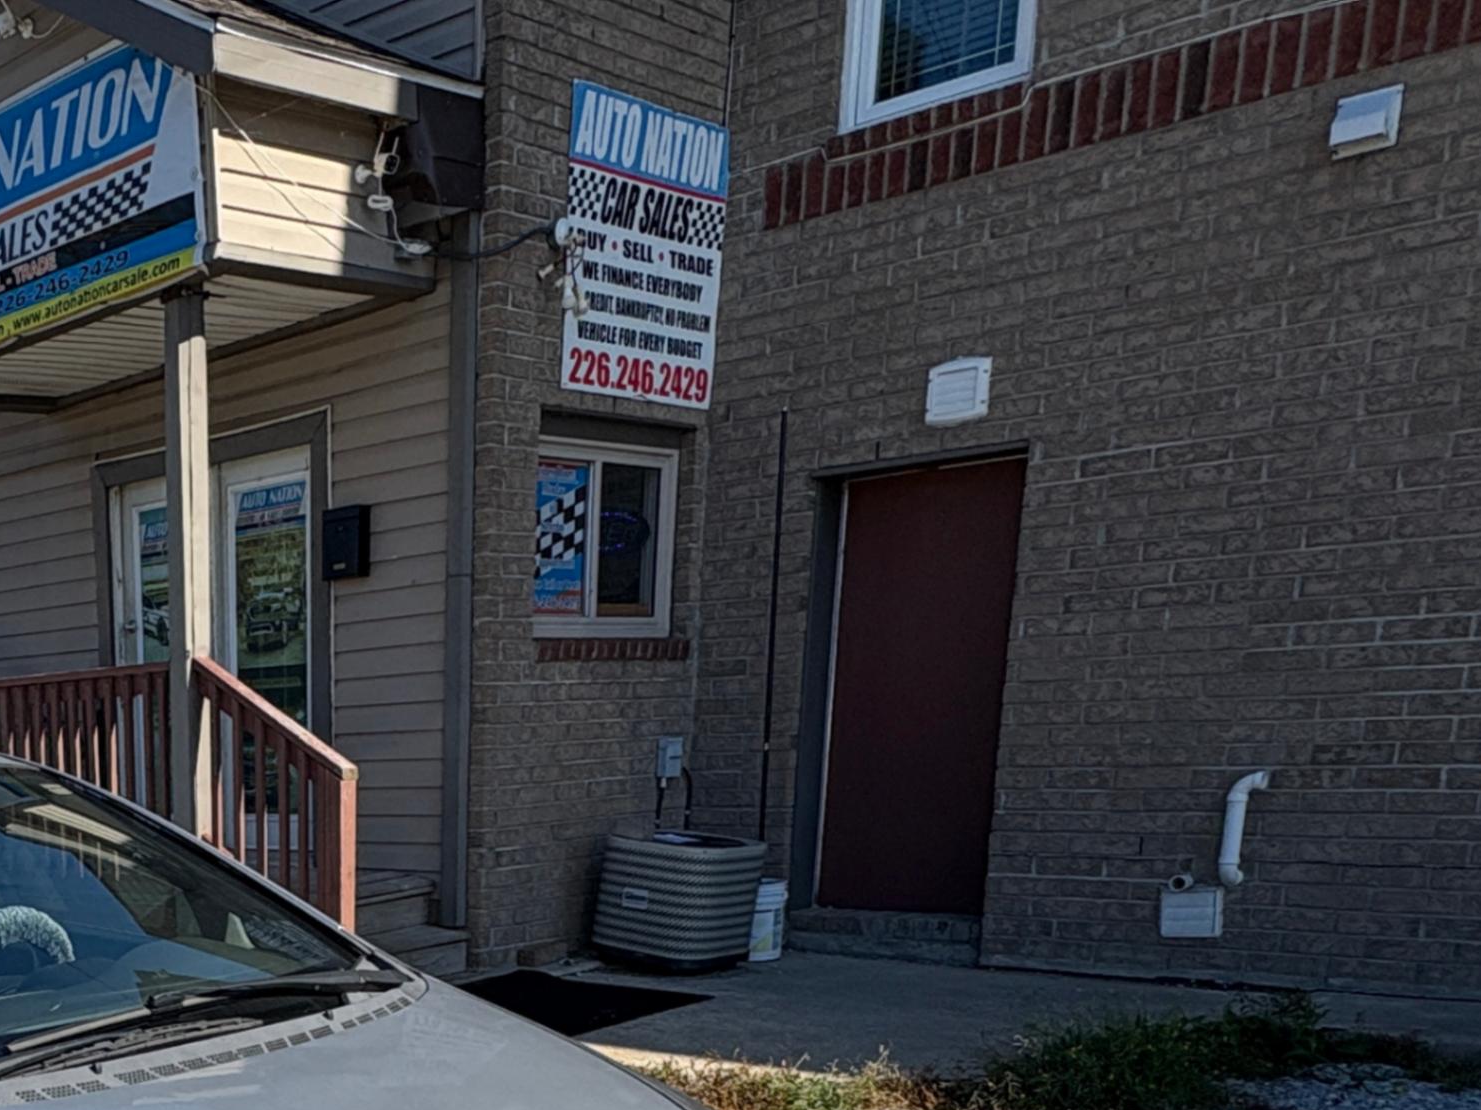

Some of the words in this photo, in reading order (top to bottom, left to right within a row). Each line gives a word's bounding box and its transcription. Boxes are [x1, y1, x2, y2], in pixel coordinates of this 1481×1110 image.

[575, 89, 642, 168] AUTO
[640, 110, 724, 191] NATION
[601, 177, 641, 230] CAR
[638, 188, 694, 243] SALES
[11, 251, 58, 285] TRADE
[623, 239, 654, 263] SELL
[669, 250, 714, 277] TRADE
[583, 260, 599, 281] WE
[602, 264, 644, 291] FINANCE
[646, 274, 703, 304] EVERYBODY
[577, 319, 617, 345] VEHICLE
[619, 327, 637, 347] FOR
[639, 331, 666, 354] EVERY
[668, 337, 703, 361] BUDGET
[665, 307, 675, 326] NO
[676, 310, 711, 334] PROBLEM
[568, 347, 709, 403] 226.246.2429
[241, 490, 267, 509] AUTO
